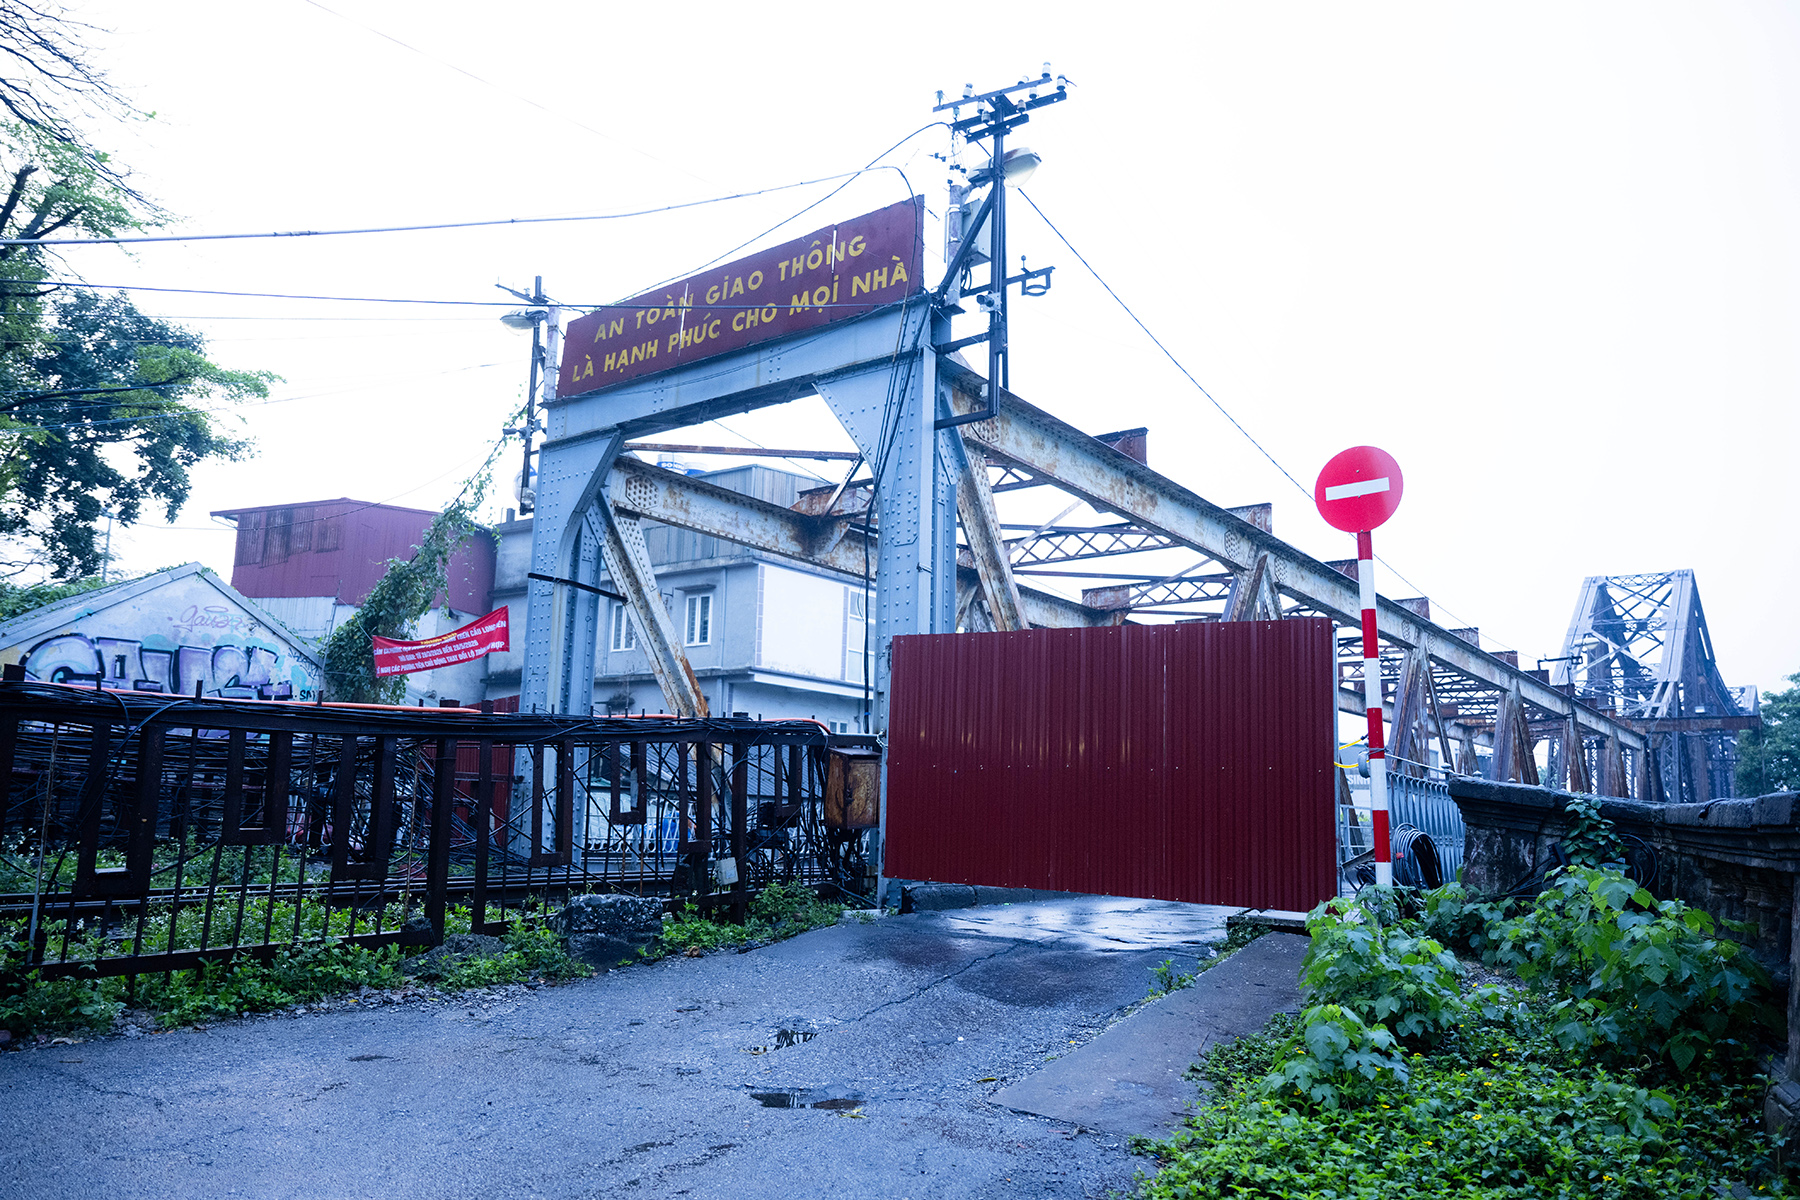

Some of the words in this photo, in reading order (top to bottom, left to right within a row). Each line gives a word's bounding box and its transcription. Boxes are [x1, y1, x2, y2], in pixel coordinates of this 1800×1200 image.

[572, 354, 594, 384] LÀ
[604, 339, 659, 374] HẠNH
[667, 312, 721, 354] PHÚC
[732, 303, 778, 333] CHO
[789, 275, 839, 315] MỌI
[851, 255, 909, 298] NHÀ
[594, 318, 625, 343] AN
[635, 293, 694, 331] TOÀN
[778, 235, 867, 283] THÔNG
